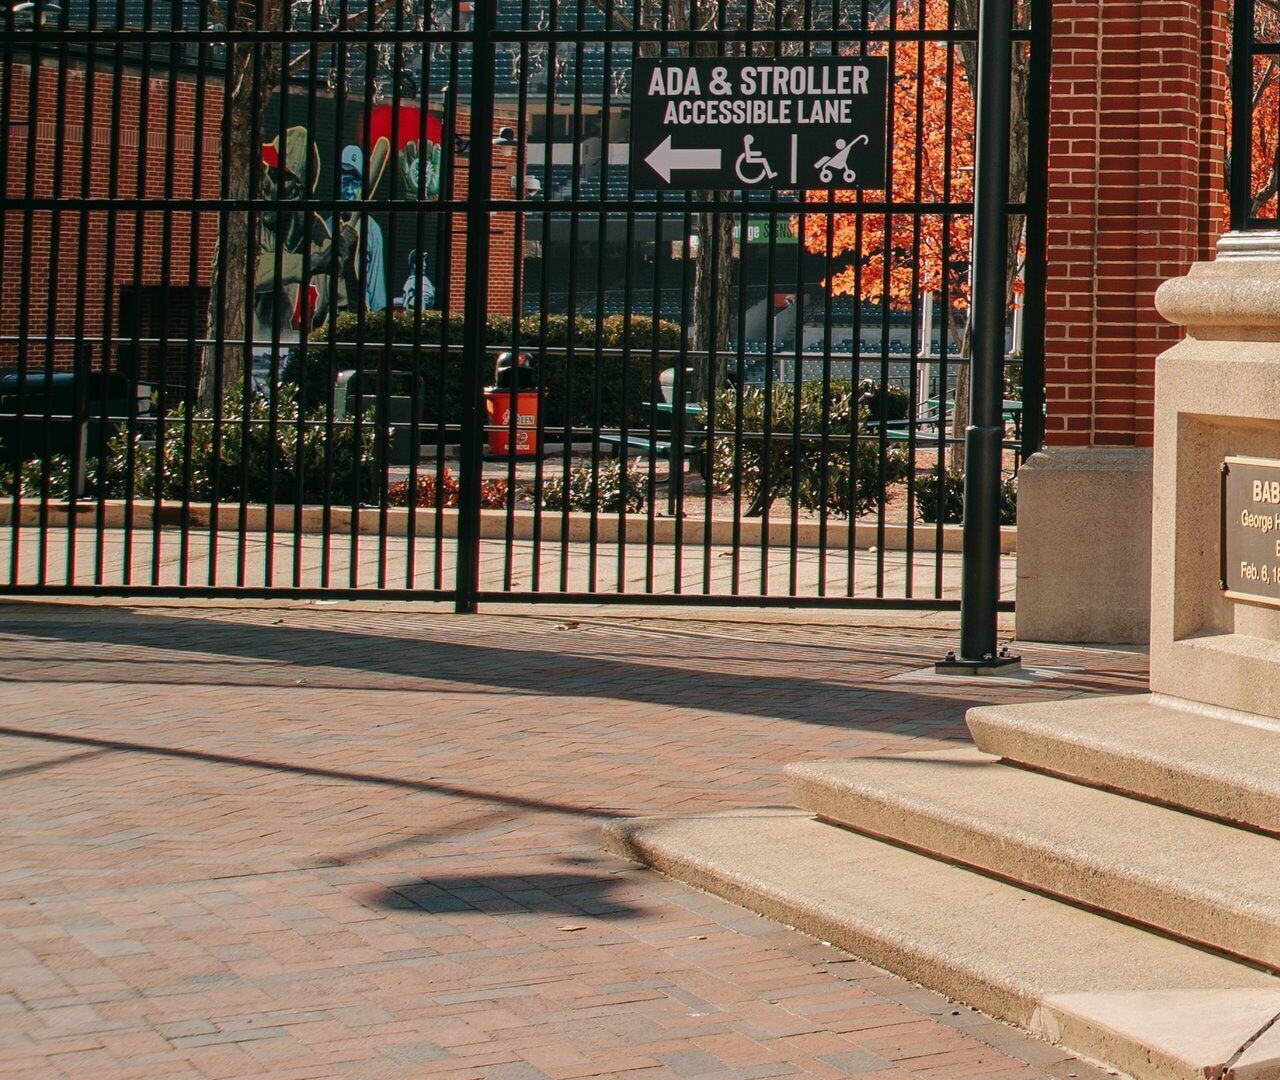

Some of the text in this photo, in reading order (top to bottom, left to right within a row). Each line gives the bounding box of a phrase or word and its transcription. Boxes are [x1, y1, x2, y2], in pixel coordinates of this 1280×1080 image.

[648, 65, 869, 96] ADA & STROLLER
[663, 99, 852, 124] ACCESSIBLE LANE
[1241, 509, 1273, 534] George
[1240, 561, 1260, 580] Feb.
[1261, 568, 1270, 585] 6,
